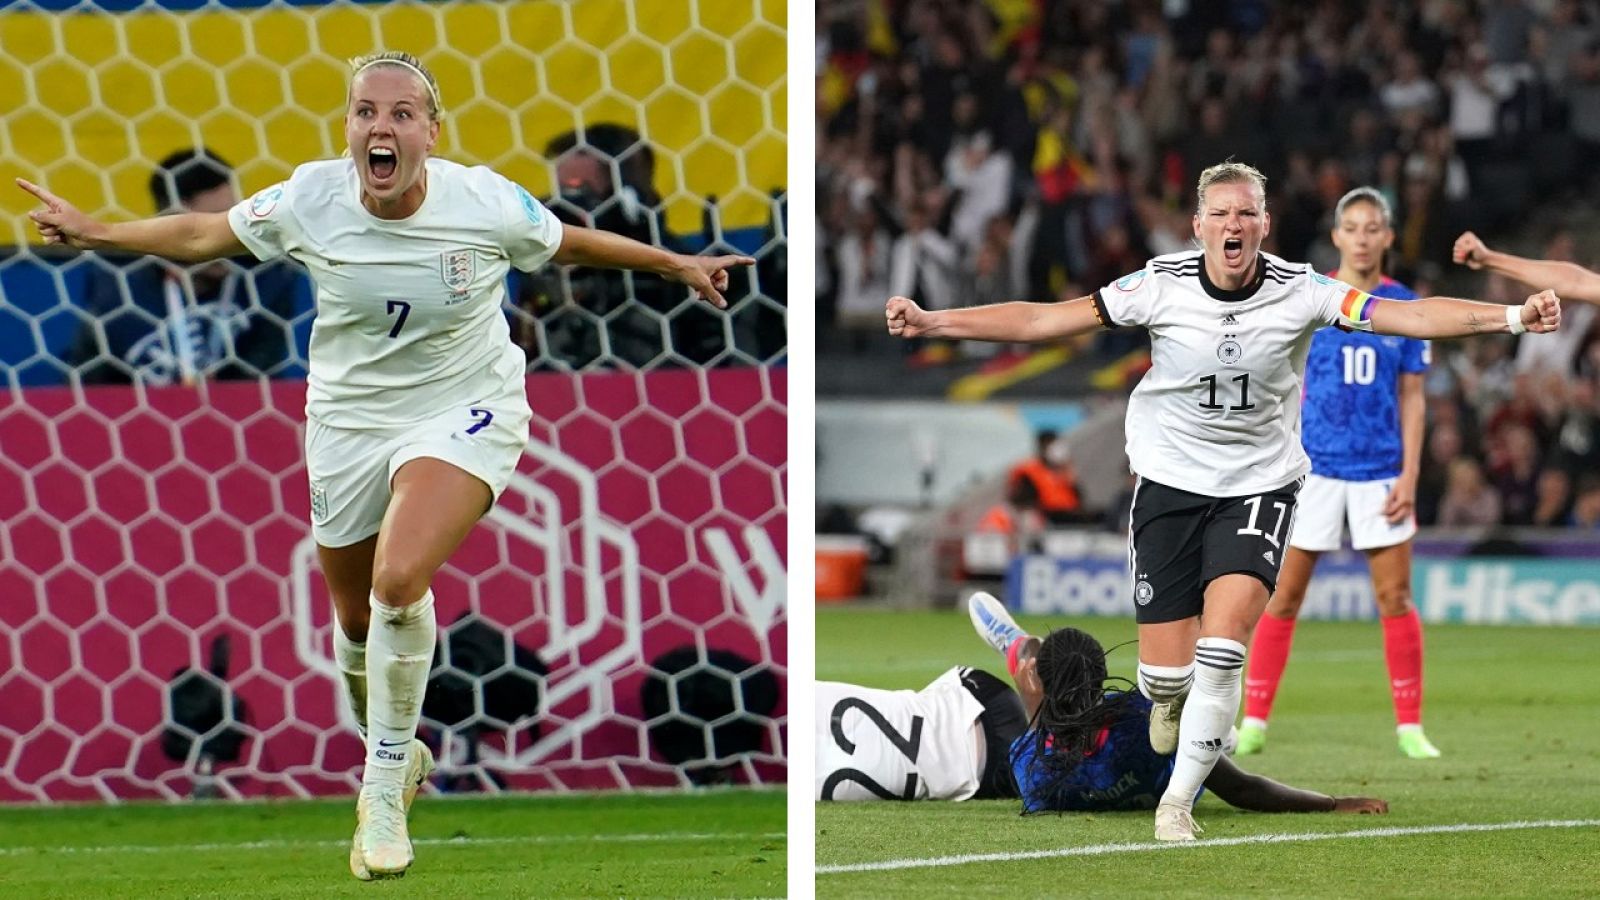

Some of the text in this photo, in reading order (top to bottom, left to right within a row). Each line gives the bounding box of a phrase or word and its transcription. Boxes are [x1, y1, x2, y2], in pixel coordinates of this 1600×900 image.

[386, 300, 411, 338] 7
[1341, 345, 1376, 385] 10
[1199, 373, 1256, 410] 11
[465, 409, 494, 435] 7
[1236, 495, 1287, 549] 11
